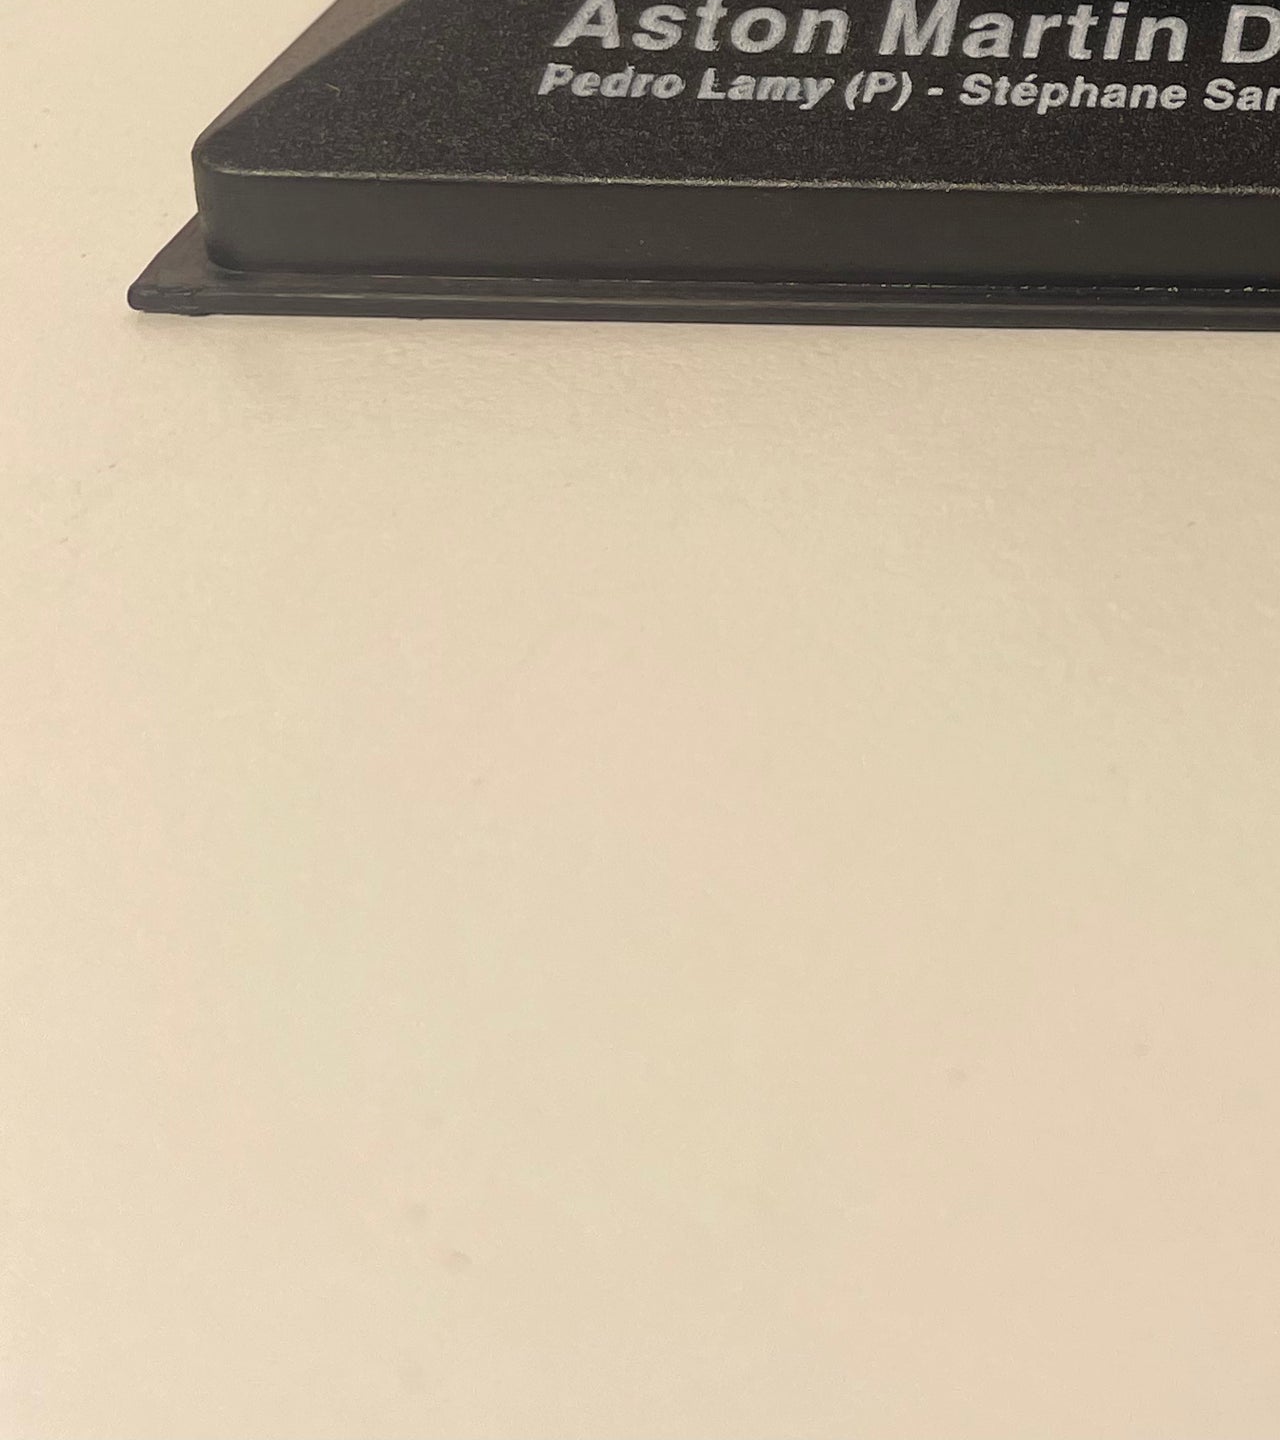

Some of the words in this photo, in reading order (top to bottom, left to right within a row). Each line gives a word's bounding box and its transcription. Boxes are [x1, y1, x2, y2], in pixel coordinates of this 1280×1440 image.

[537, 62, 686, 99] Pedro
[697, 68, 836, 110] Lamy
[844, 69, 914, 112] (P)
[959, 72, 1188, 115] Stéphane
